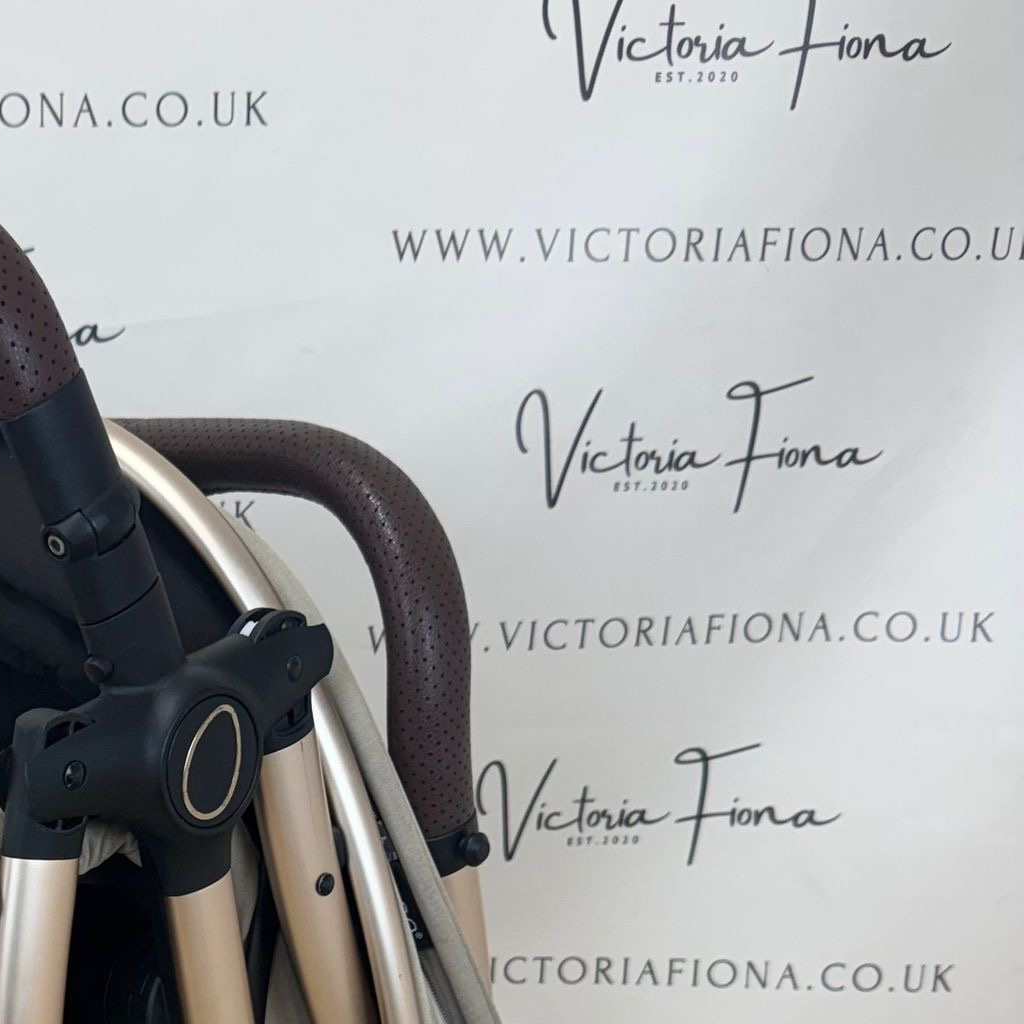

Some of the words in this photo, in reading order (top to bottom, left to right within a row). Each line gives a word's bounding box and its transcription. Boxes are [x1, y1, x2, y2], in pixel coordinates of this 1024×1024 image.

[542, 0, 775, 101] Victoria
[655, 71, 740, 84] EST.2020
[391, 226, 1024, 264] WWW.VICTORIAFIONA.CO.U
[515, 388, 722, 509] Victoria
[725, 376, 883, 513] Fiona
[613, 480, 690, 493] EST.2020
[476, 758, 671, 861] Victoria
[674, 742, 842, 866] Fiona
